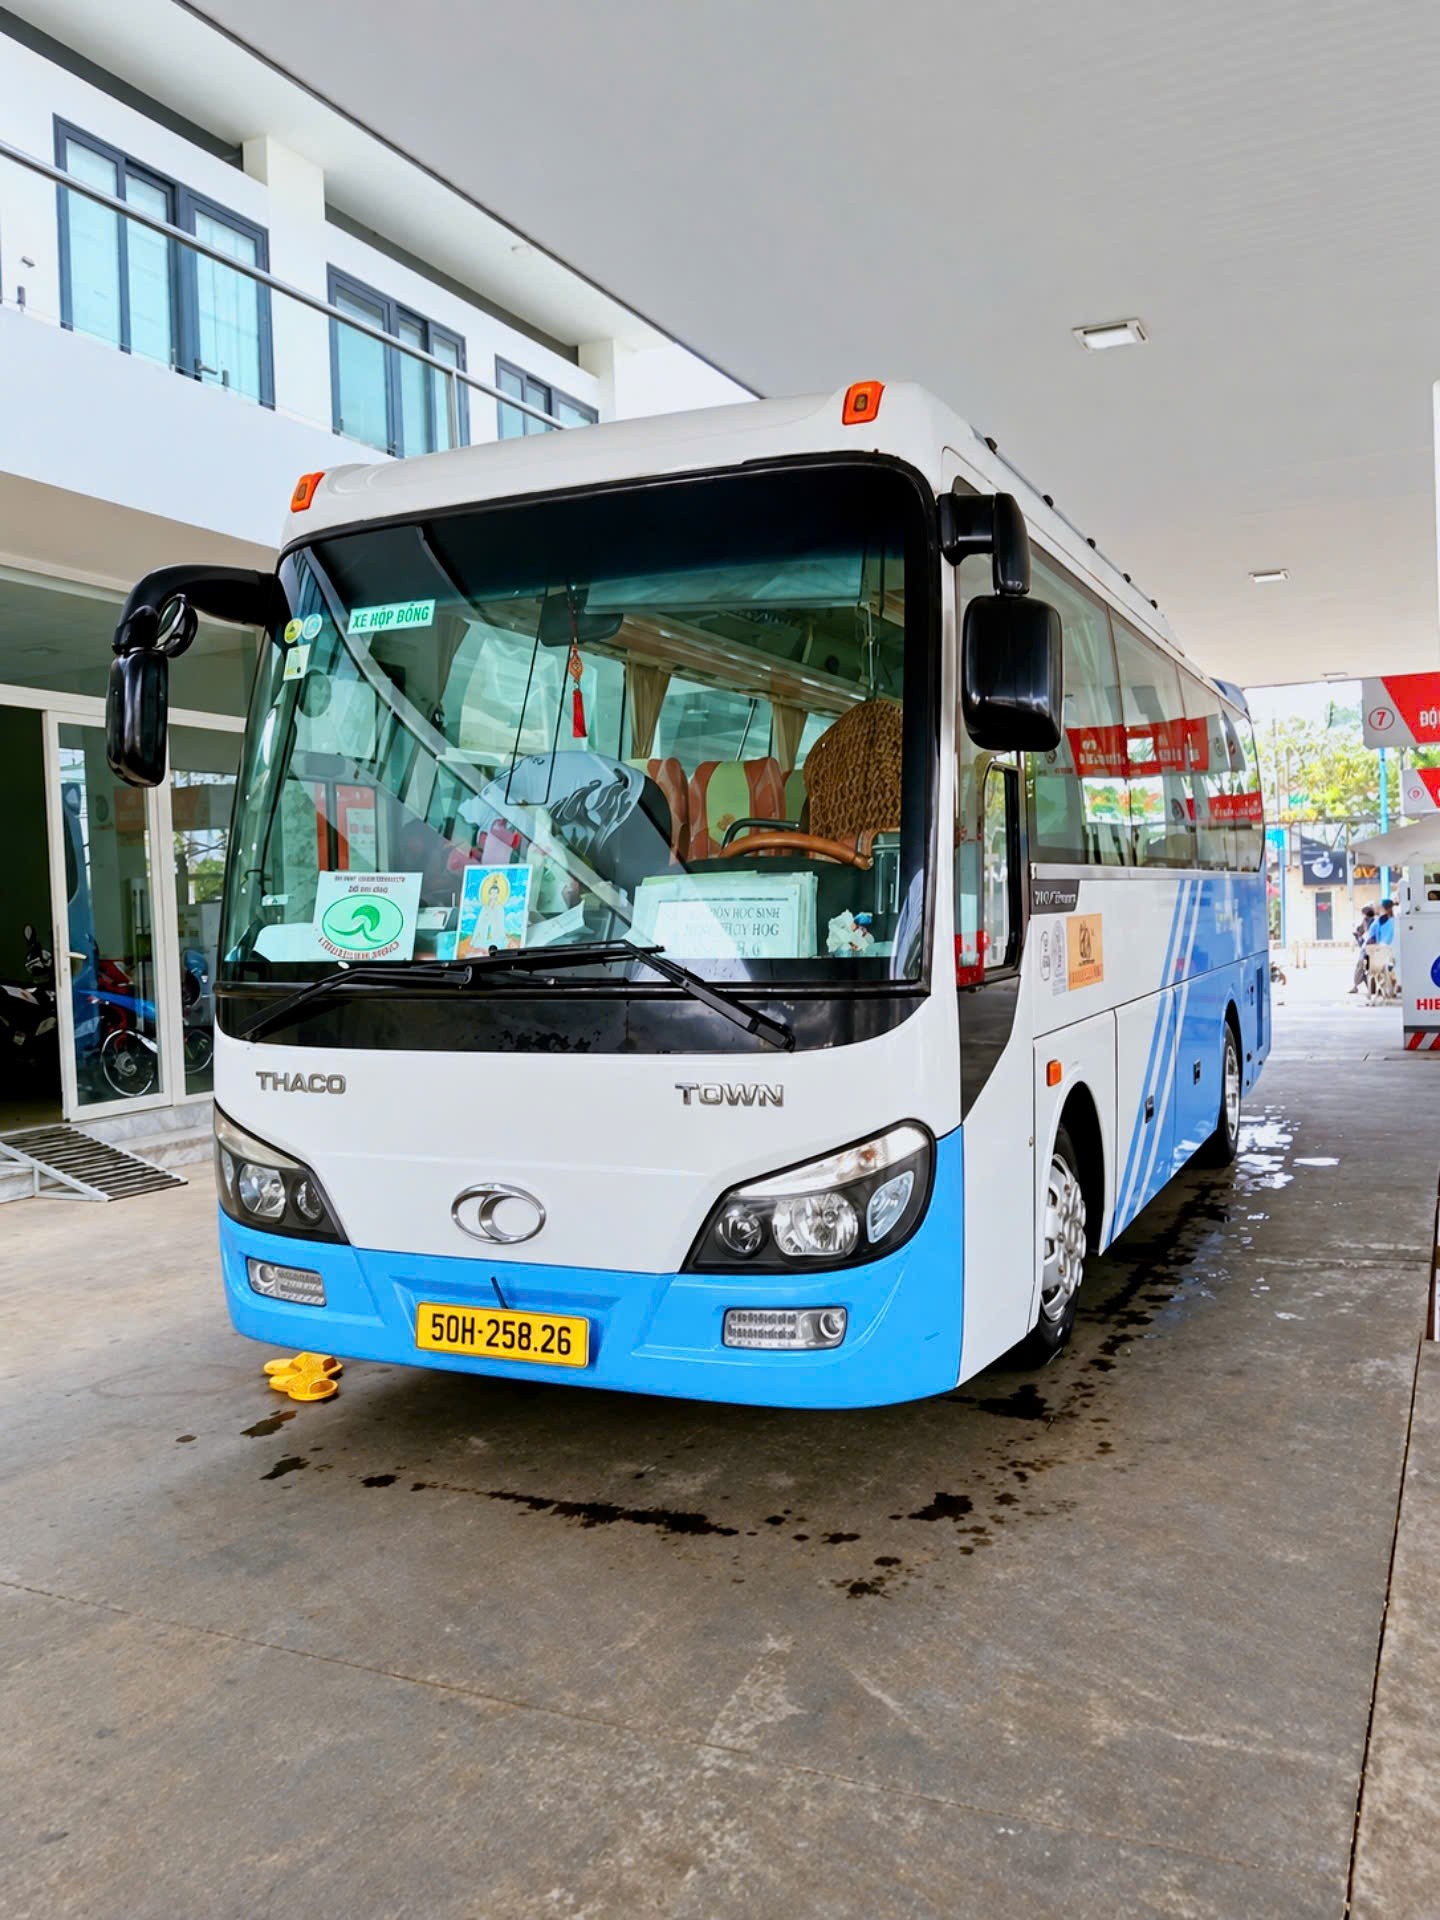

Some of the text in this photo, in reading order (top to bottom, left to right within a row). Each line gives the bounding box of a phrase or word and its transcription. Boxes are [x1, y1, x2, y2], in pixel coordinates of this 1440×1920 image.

[352, 613, 368, 629] XE
[255, 1071, 346, 1095] THACO
[674, 1081, 784, 1107] TOWN
